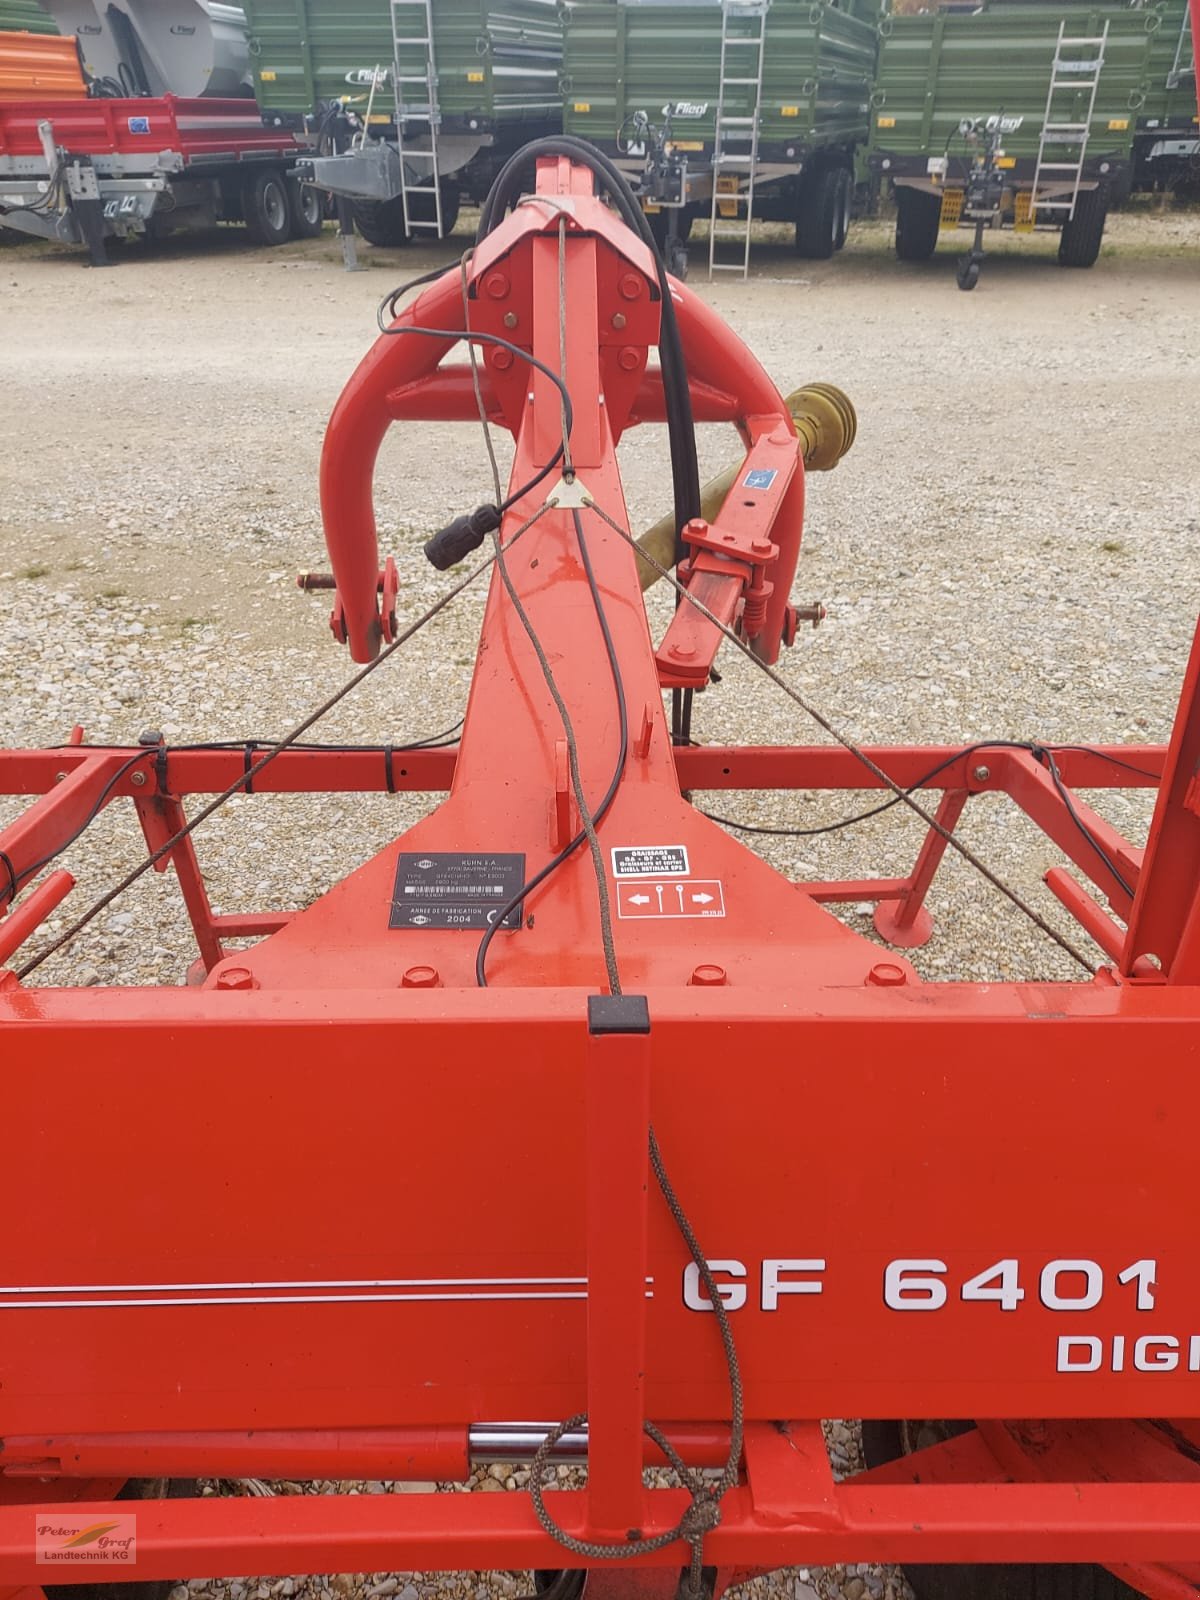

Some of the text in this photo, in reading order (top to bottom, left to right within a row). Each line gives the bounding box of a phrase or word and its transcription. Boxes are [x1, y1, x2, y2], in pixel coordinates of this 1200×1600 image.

[446, 915, 471, 923] 2004
[682, 1258, 1159, 1312] GF 6401
